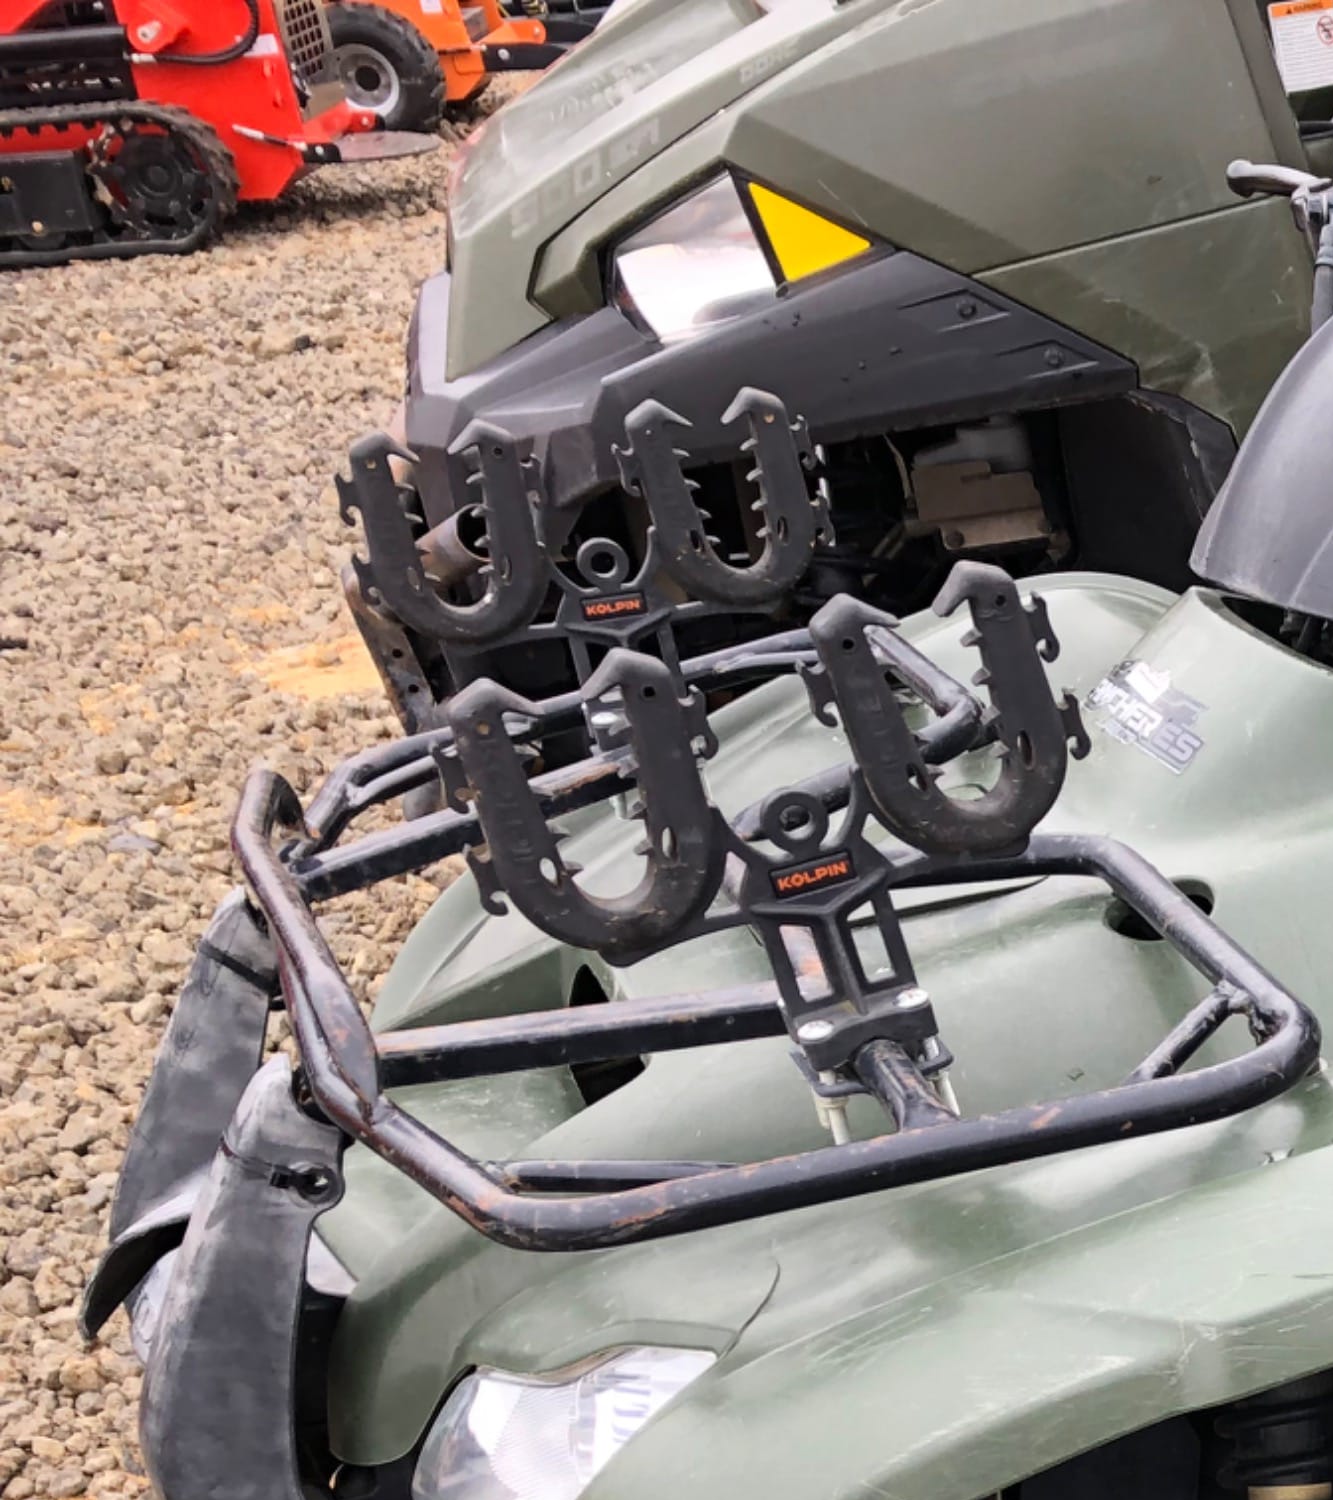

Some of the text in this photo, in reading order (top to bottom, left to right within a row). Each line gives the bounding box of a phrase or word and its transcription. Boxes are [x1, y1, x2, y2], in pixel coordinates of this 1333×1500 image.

[586, 599, 641, 616] KOLPIN
[1150, 723, 1205, 765] ES
[777, 861, 848, 891] KOLPIN
